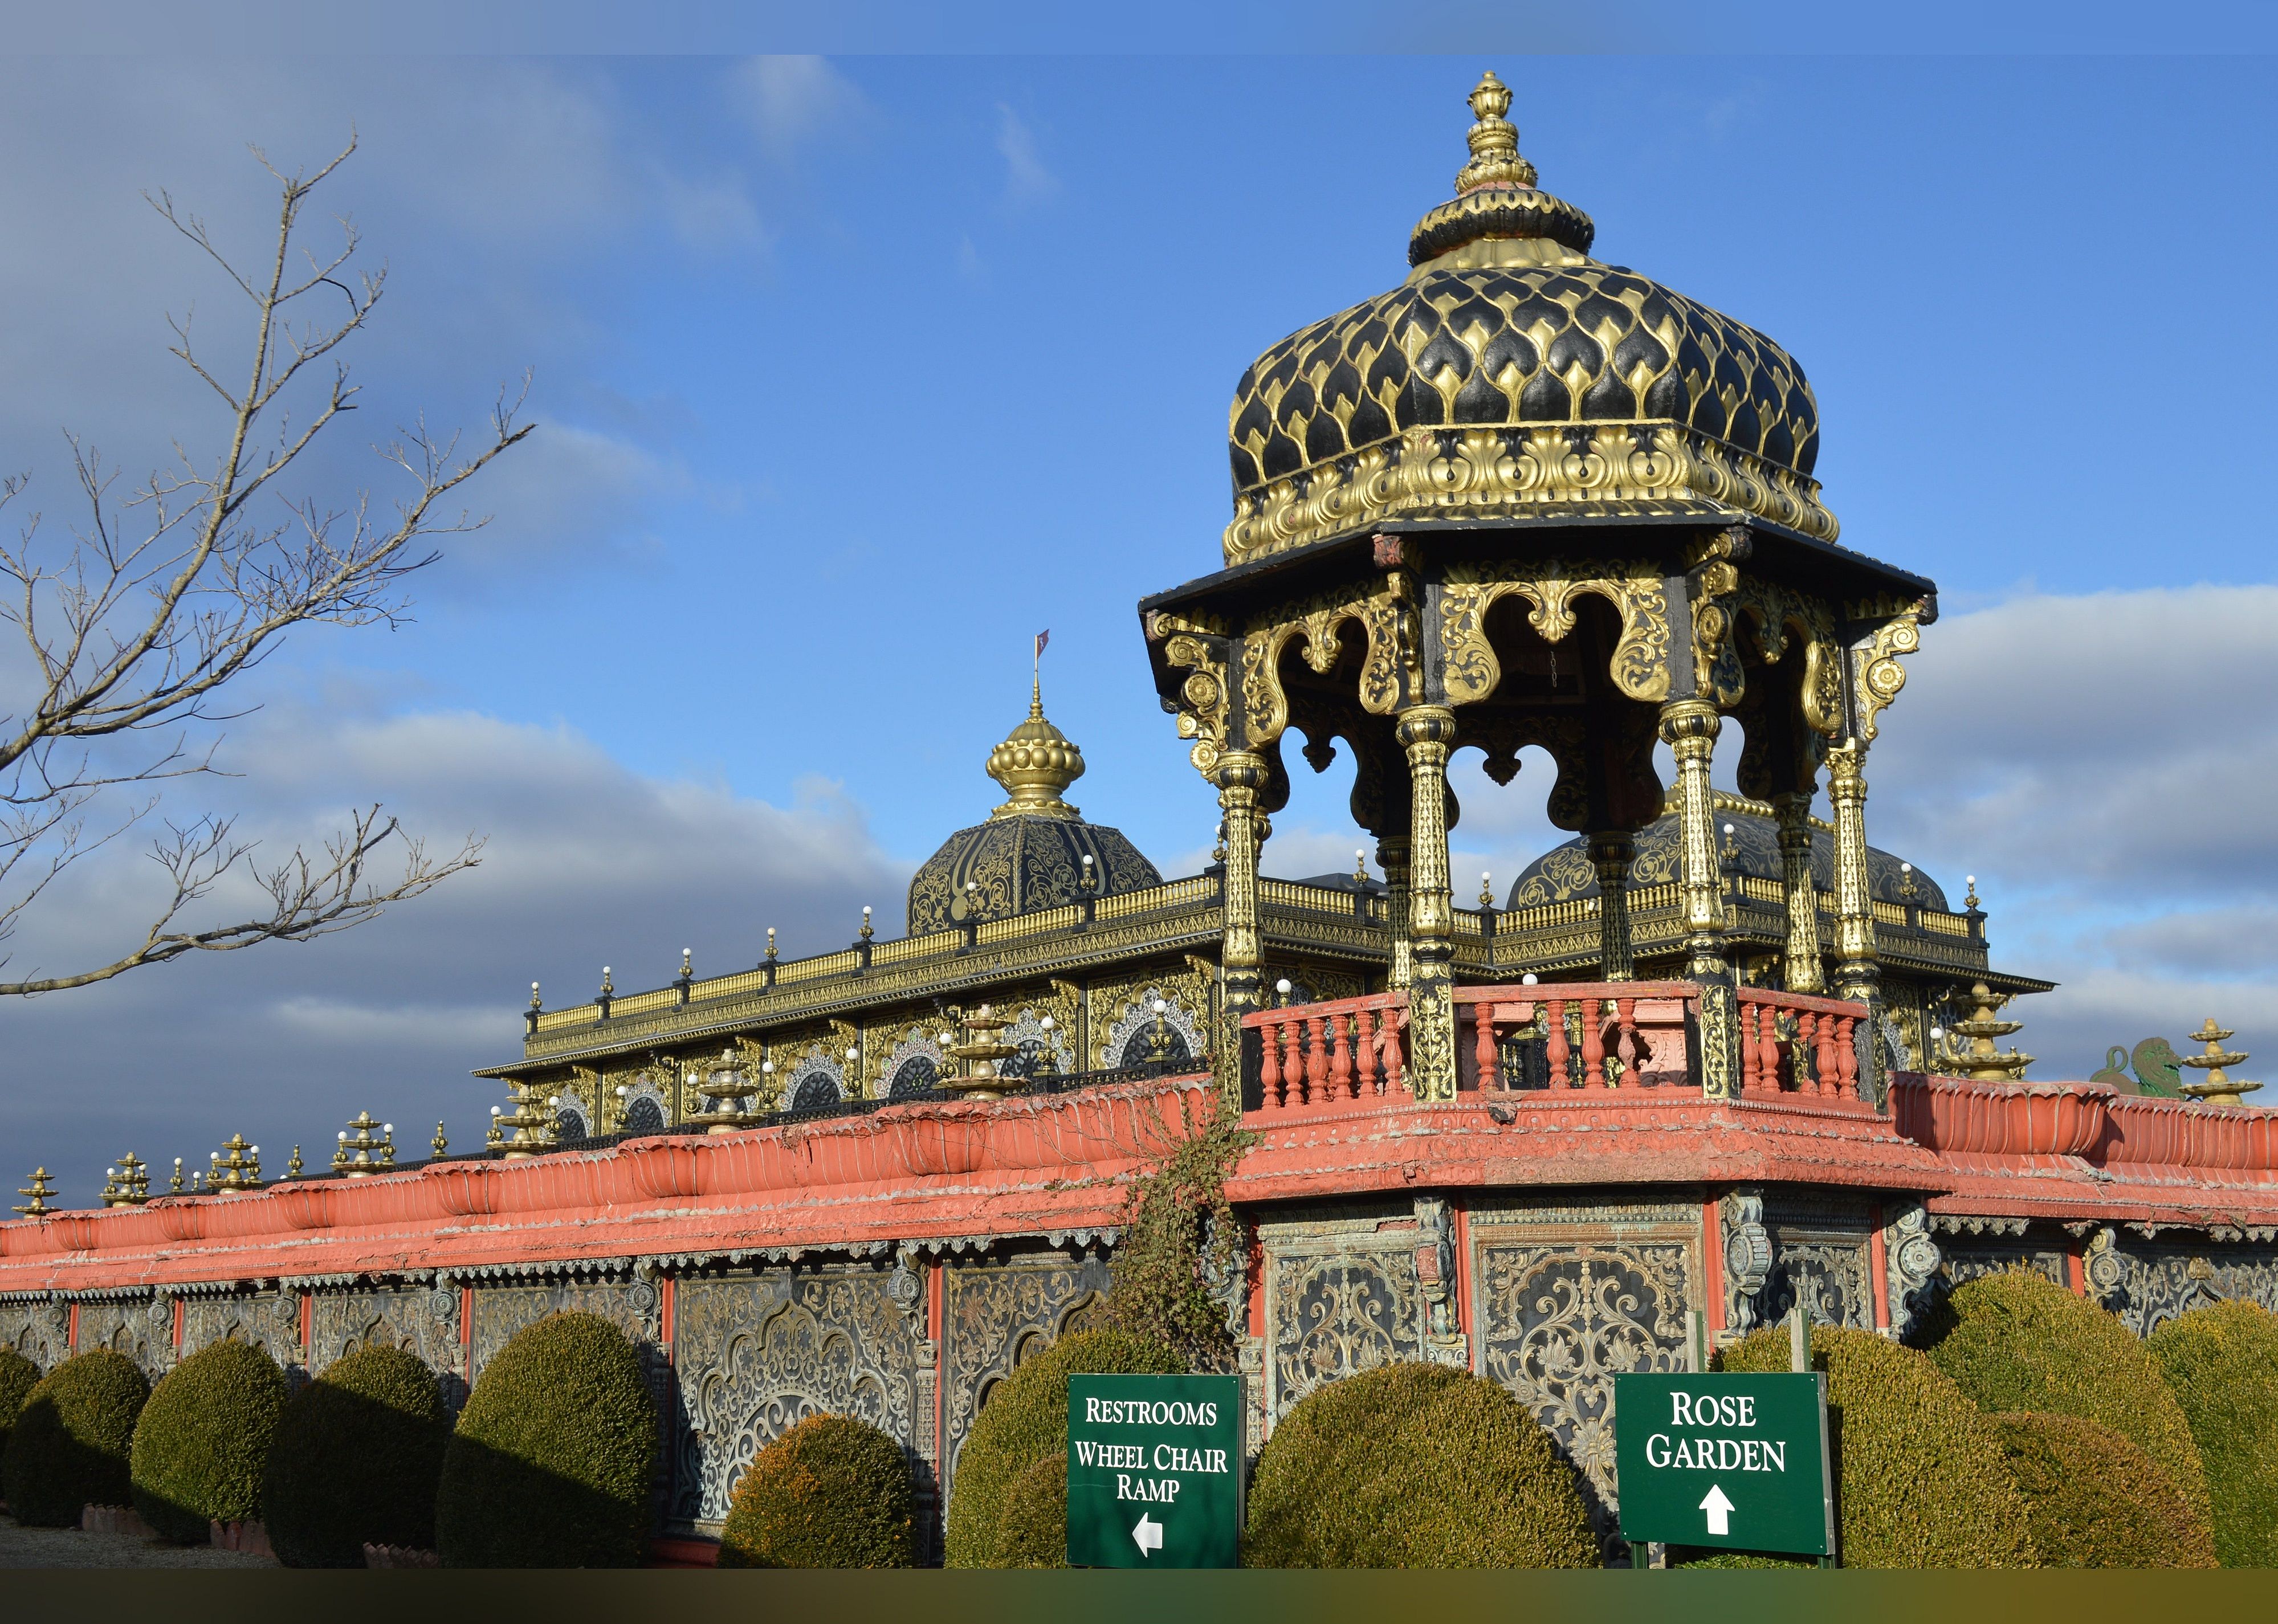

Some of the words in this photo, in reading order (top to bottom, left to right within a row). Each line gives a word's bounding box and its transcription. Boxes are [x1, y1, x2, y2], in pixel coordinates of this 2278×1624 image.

[1086, 1398, 1216, 1426] RESTROOMS
[1670, 1392, 1756, 1426] ROSE
[1075, 1441, 1148, 1468] WHEEL
[1154, 1445, 1228, 1472] CHAIR
[1647, 1434, 1786, 1472] GARDEN
[1117, 1474, 1179, 1502] RAMP
